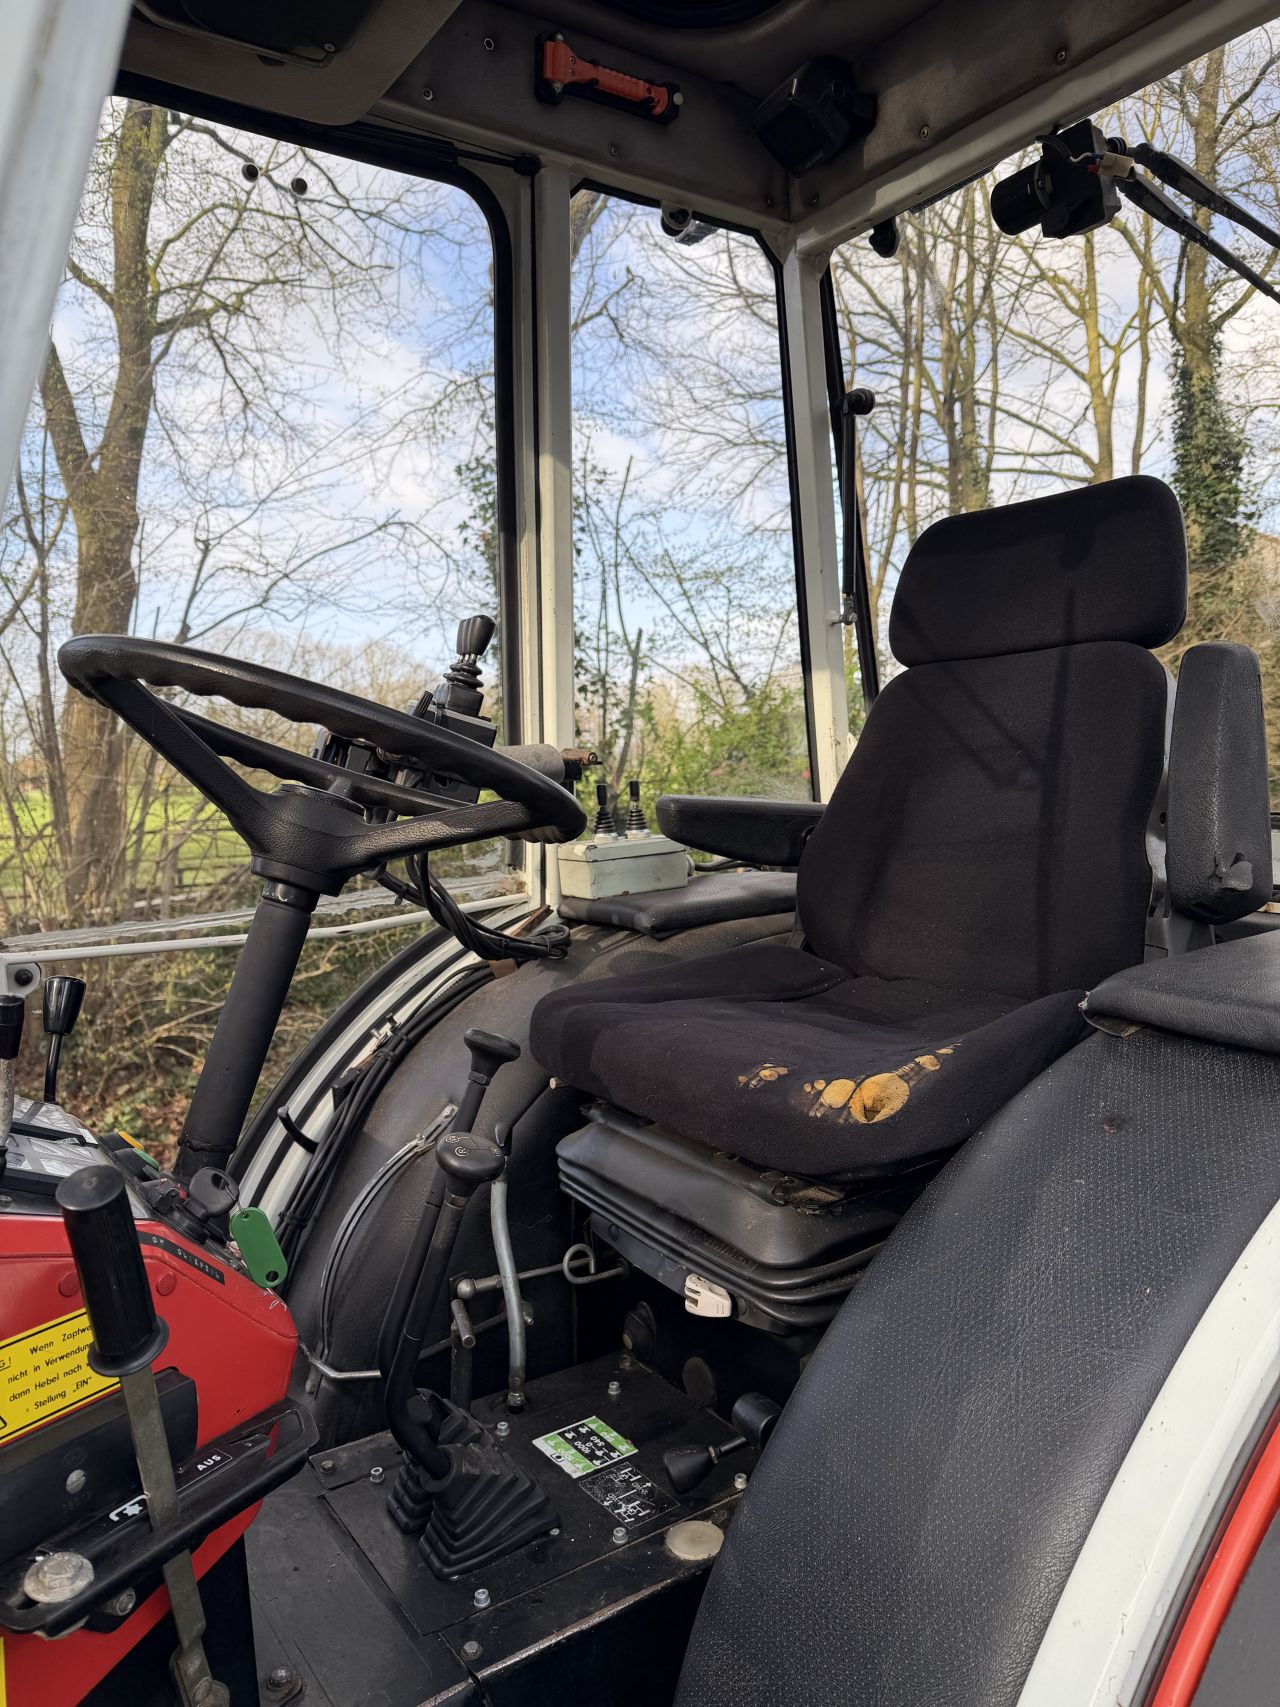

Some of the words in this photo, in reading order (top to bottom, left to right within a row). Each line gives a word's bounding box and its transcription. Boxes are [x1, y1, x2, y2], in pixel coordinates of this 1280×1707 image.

[29, 1340, 54, 1355] Wenn
[8, 1369, 28, 1384] nicht
[33, 1364, 41, 1373] in
[9, 1388, 31, 1402] dann
[34, 1373, 60, 1390] Hebel
[63, 1364, 82, 1377] nach
[34, 1390, 67, 1408] Stellung
[574, 1440, 591, 1454] 1000
[590, 1435, 605, 1447] 540
[196, 1455, 221, 1471] AUS
